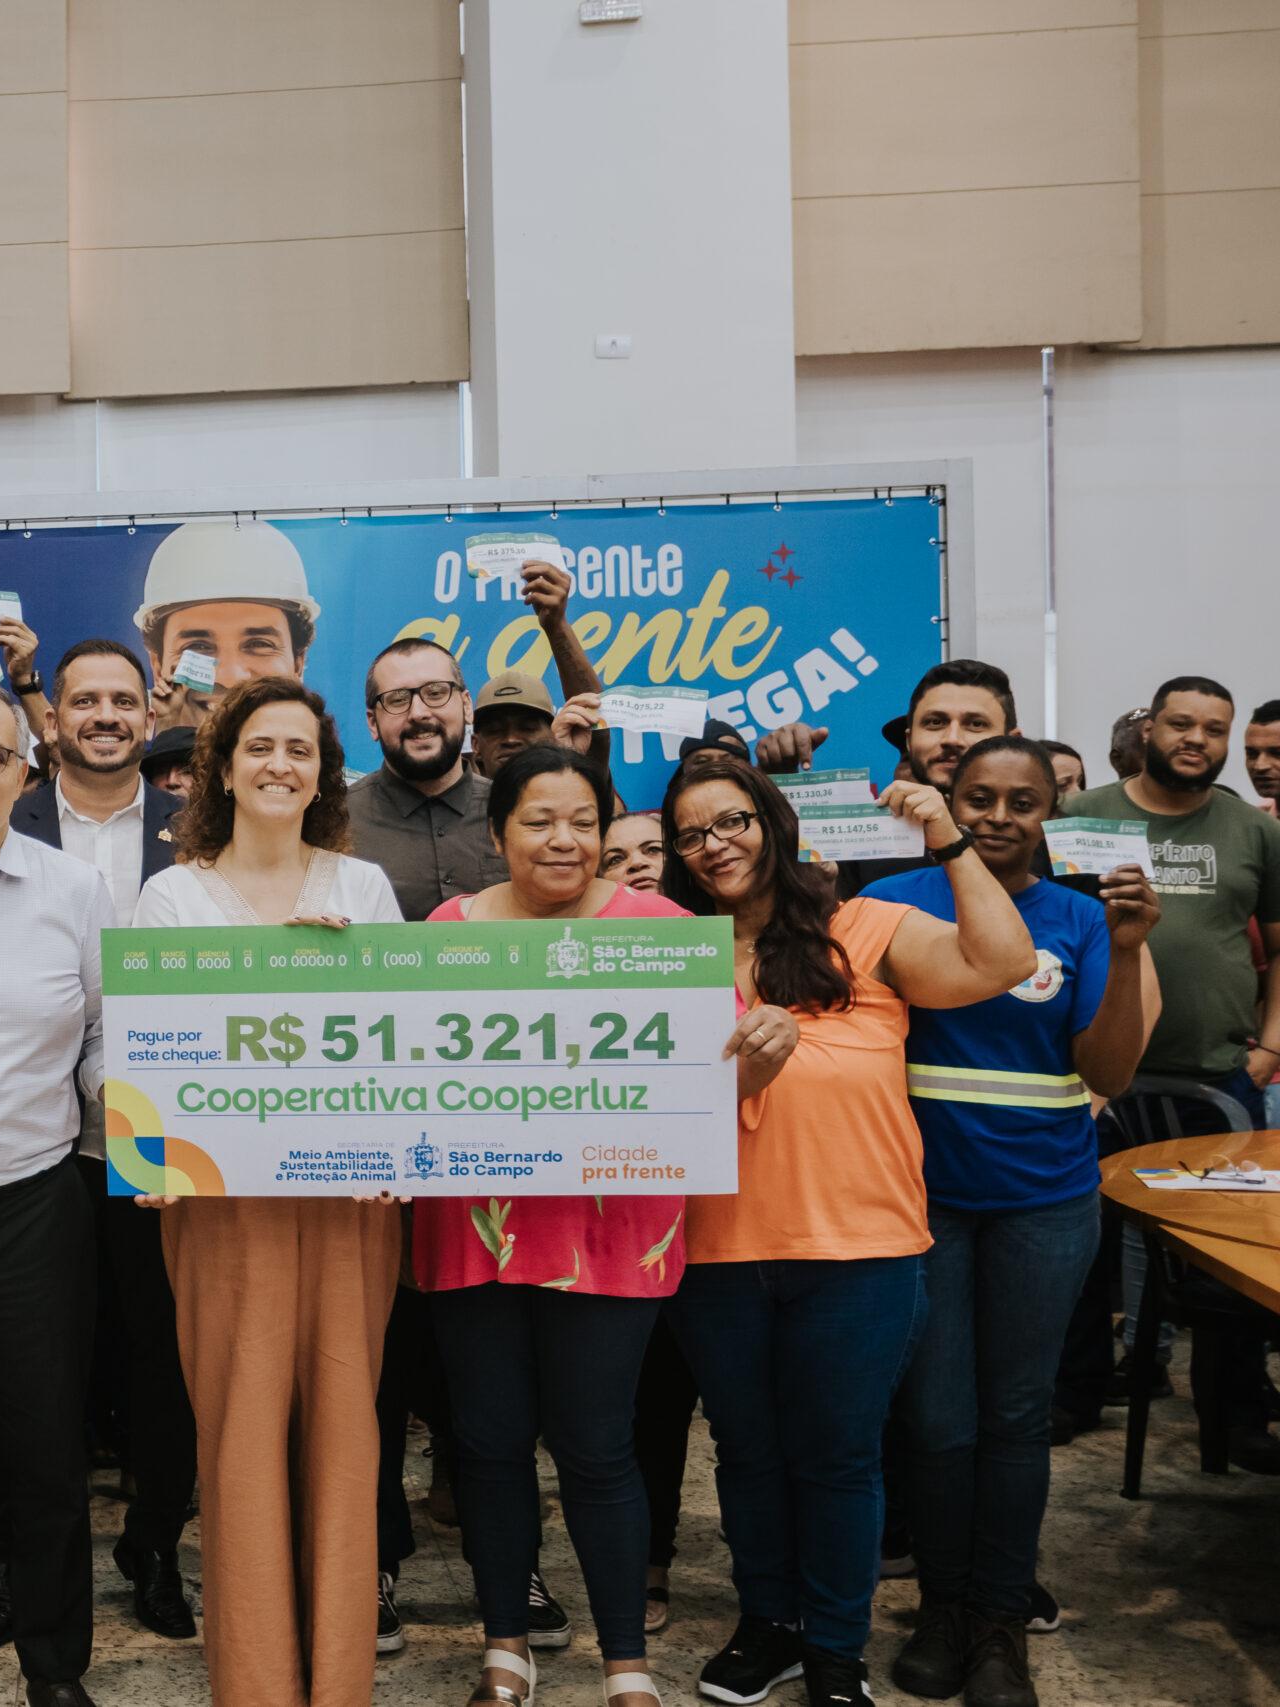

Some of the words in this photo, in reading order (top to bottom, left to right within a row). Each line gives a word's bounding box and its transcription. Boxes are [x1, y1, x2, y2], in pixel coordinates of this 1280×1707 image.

[434, 551, 461, 603] O
[822, 826, 835, 834] R$
[837, 824, 879, 834] 1.147,56
[1149, 866, 1200, 885] ANTO
[591, 935, 654, 943] PREFEITURA
[592, 945, 626, 959] São
[631, 942, 718, 958] Bernardo
[123, 958, 149, 970] 000
[161, 957, 187, 969] 000
[196, 957, 231, 969] 0000
[243, 956, 253, 968] 0
[270, 955, 287, 968] 00
[290, 954, 334, 967] 00000
[362, 954, 371, 966] 0
[383, 951, 422, 968] (000)
[437, 952, 490, 965] 000000
[509, 951, 519, 964] 0
[593, 959, 616, 972] do
[621, 959, 686, 975] Campo
[127, 1030, 175, 1046] Pague
[177, 1031, 202, 1046] por
[226, 1012, 307, 1068] R$
[321, 1012, 676, 1070] 51.321,24
[128, 1050, 159, 1062] este
[162, 1048, 221, 1065] cheque:
[177, 1077, 427, 1123] Cooperativa
[437, 1077, 648, 1122] Cooperluz
[289, 1150, 322, 1160] Meio
[325, 1149, 393, 1161] Ambiente,
[448, 1150, 480, 1163] São
[484, 1150, 563, 1163] Bernardo
[582, 1145, 659, 1162] Cidade
[279, 1160, 394, 1171] Sustentabilidade
[449, 1164, 470, 1177] do
[474, 1164, 534, 1179] Campo
[275, 1173, 283, 1181] e
[286, 1171, 348, 1183] Proteção
[350, 1170, 396, 1181] Animal
[582, 1167, 617, 1184] pra
[622, 1164, 686, 1179] frente
